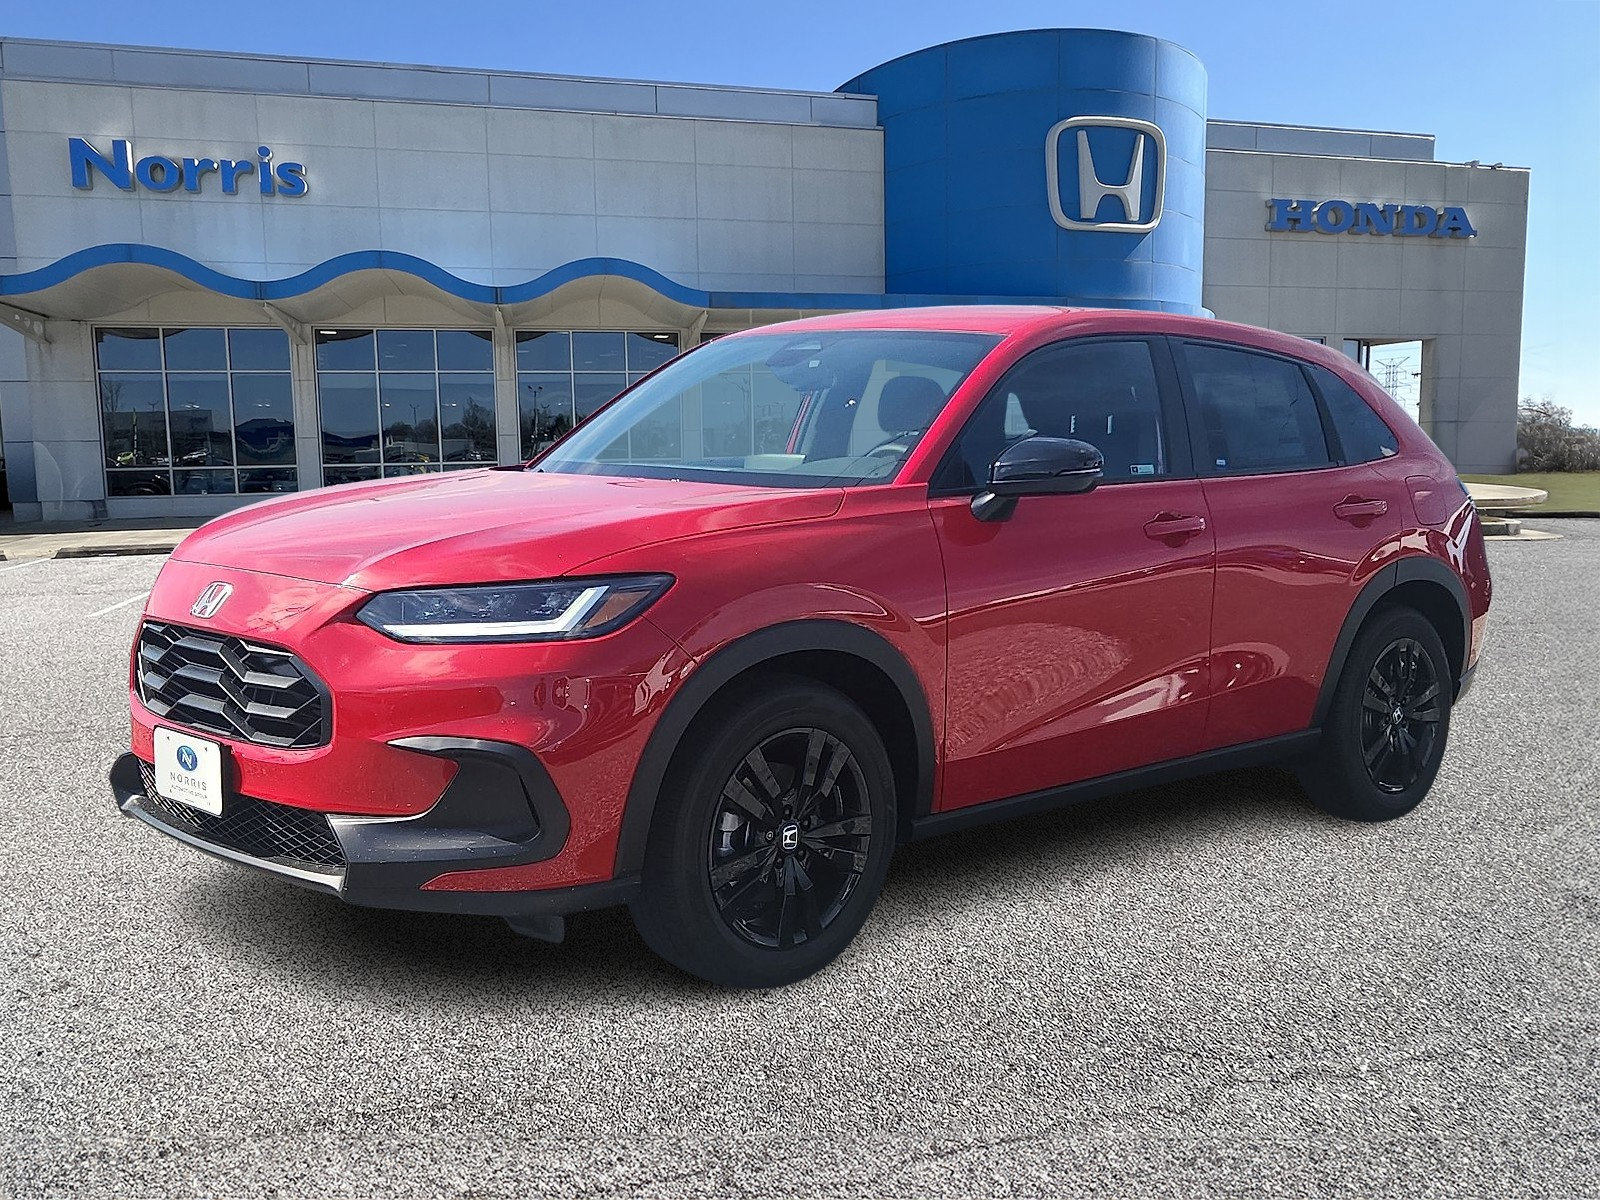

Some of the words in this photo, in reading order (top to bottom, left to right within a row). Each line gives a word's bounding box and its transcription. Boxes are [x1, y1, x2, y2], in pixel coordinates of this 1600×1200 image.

[68, 137, 309, 197] Norris
[1265, 198, 1478, 238] HONDA
[169, 771, 207, 791] NORRIS
